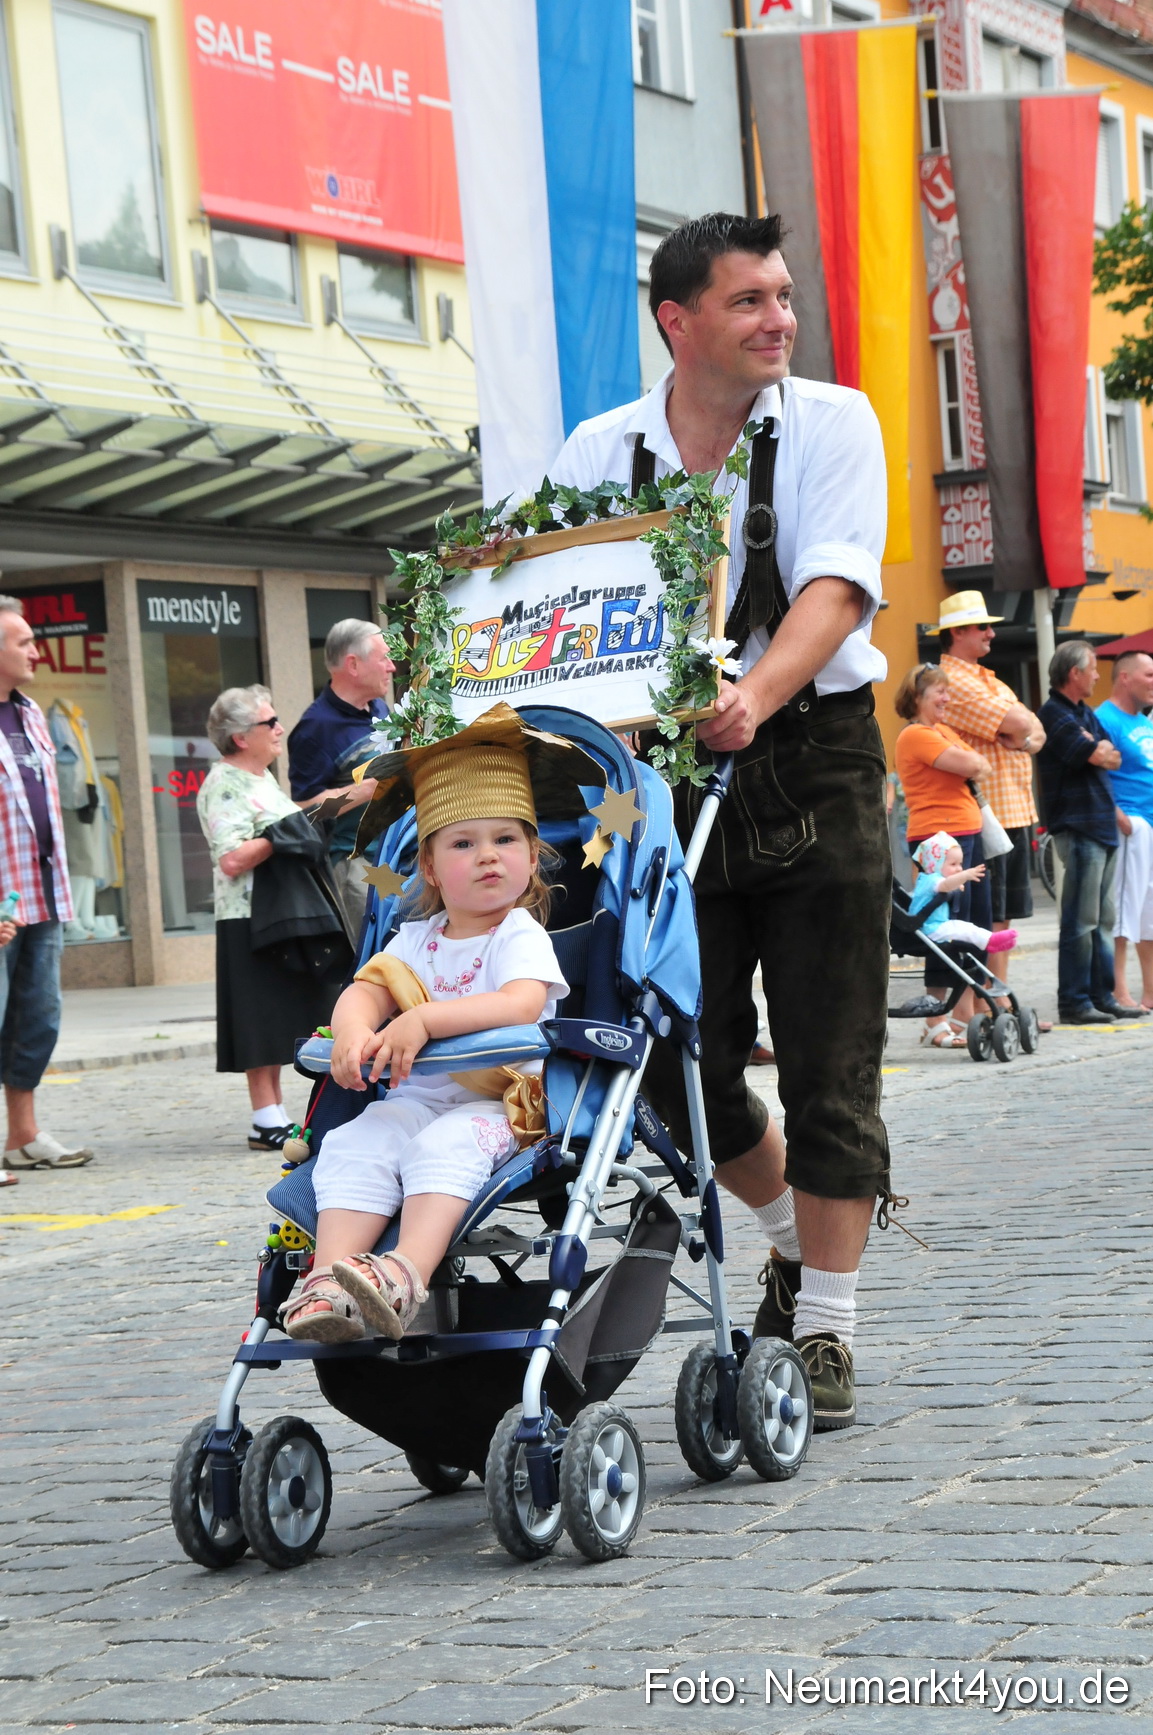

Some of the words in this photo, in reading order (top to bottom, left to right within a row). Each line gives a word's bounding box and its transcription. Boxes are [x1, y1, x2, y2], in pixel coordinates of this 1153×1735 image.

[195, 14, 275, 70] SALE
[337, 55, 411, 106] SALE
[147, 590, 242, 634] menstyle
[502, 584, 646, 627] Musicalgruppe
[32, 633, 107, 674] ALE
[600, 1032, 625, 1048] Inglesina
